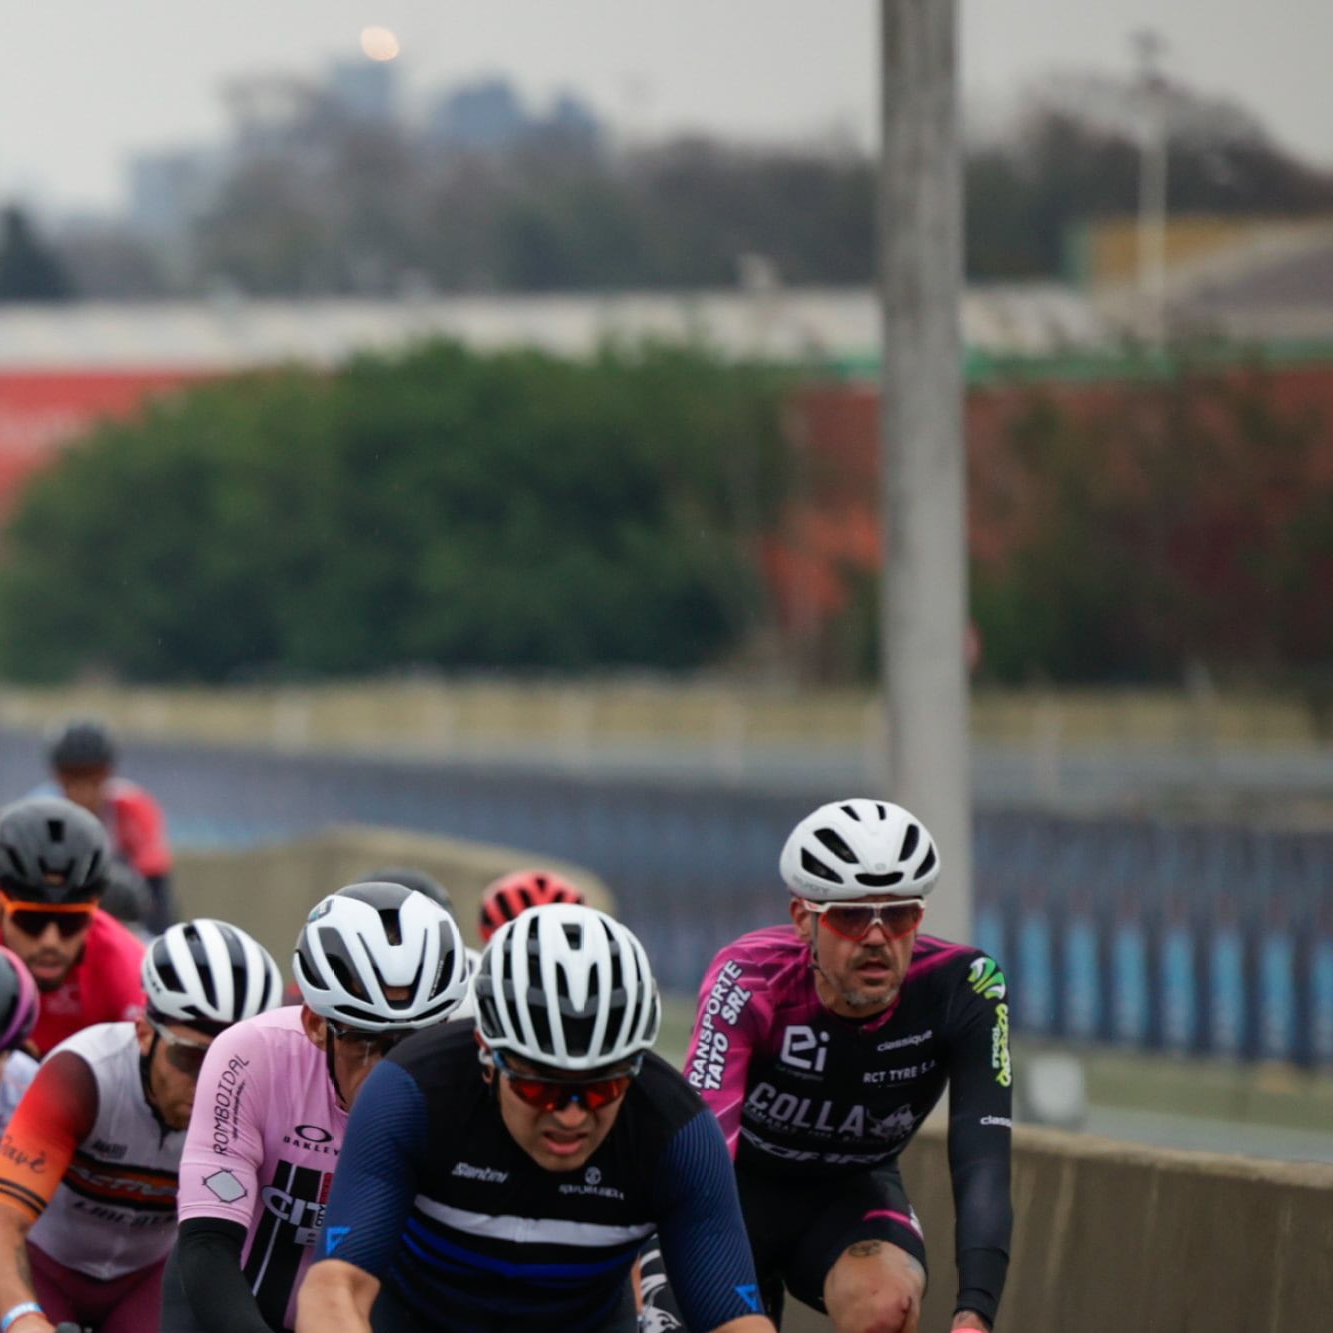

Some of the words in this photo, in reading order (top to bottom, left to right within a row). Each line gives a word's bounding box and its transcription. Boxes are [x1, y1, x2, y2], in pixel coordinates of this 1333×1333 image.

[689, 960, 742, 1094] RANSPORTE
[704, 1032, 728, 1090] TATO
[720, 984, 751, 1025] SRL
[877, 1029, 933, 1052] classique
[863, 1072, 886, 1083] RCT
[889, 1066, 918, 1081] TYRE
[213, 1055, 250, 1156] ROMBOIDAL
[748, 1082, 865, 1138] COLLA
[283, 1135, 339, 1156] OAKLEY
[451, 1161, 508, 1184] Santini
